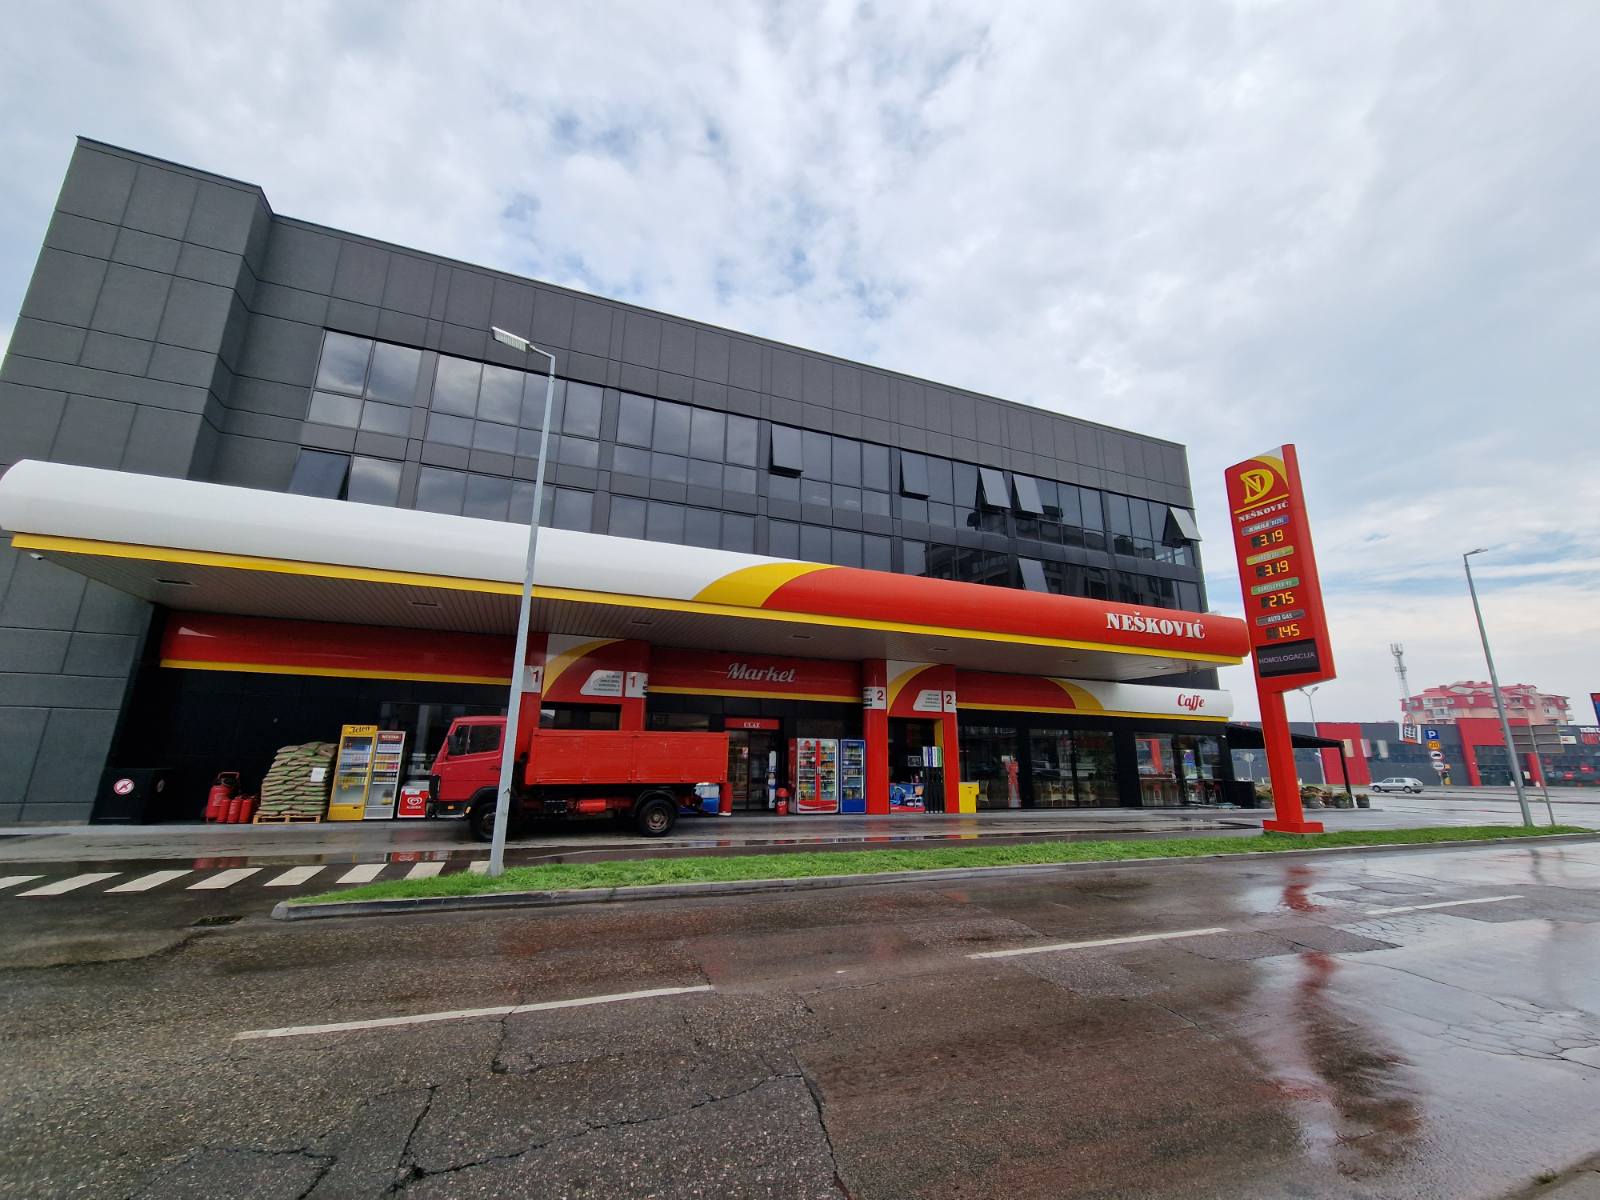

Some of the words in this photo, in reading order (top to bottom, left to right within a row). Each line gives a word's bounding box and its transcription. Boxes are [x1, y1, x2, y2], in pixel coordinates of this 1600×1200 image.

[1104, 611, 1206, 639] NEŠKOVIĆ
[532, 669, 540, 683] 1
[726, 662, 797, 683] Market
[628, 675, 637, 688] 1
[876, 690, 884, 701] 2
[945, 694, 953, 705] 2
[1177, 693, 1205, 711] Caffe
[1427, 730, 1437, 739] P
